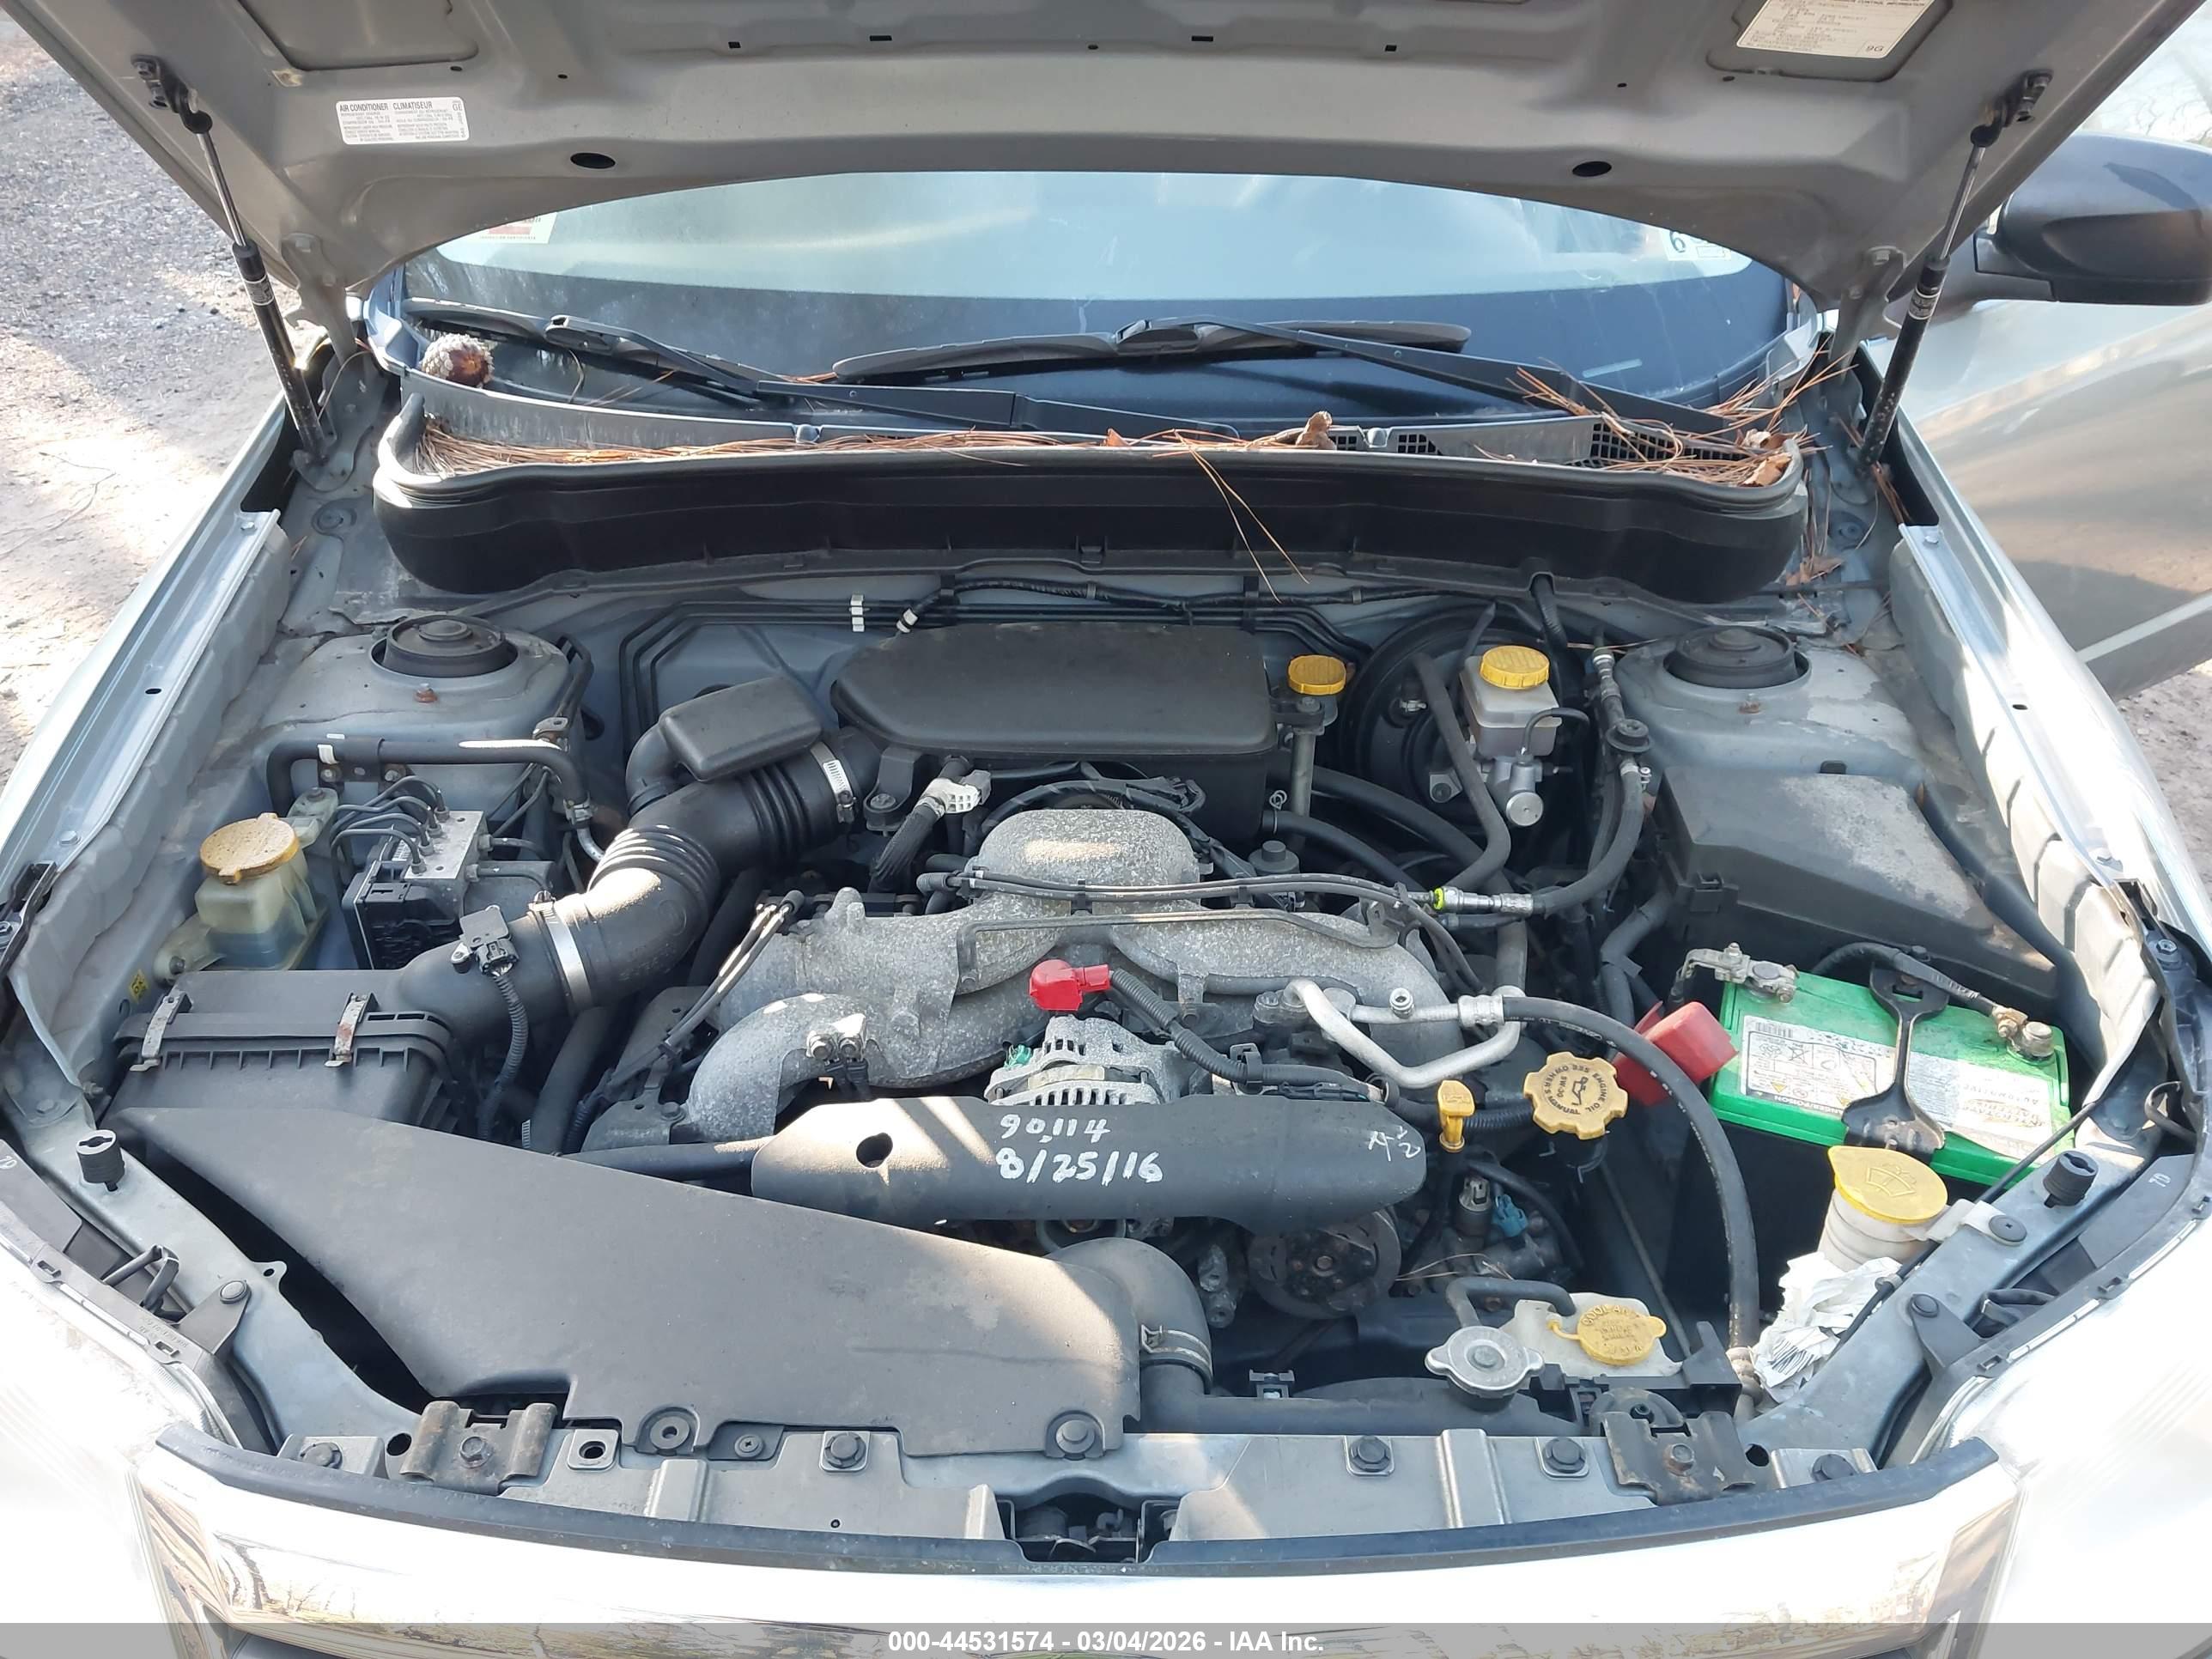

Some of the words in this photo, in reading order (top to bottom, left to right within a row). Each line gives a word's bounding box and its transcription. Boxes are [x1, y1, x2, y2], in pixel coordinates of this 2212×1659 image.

[339, 102, 349, 112] AIR
[350, 102, 389, 112] CONDITIONER
[392, 100, 433, 111] CLIMATISEUR
[1591, 1072, 1608, 1103] ENGINE
[1547, 1095, 1581, 1115] MANUAL
[1584, 1102, 1601, 1113] OIL
[1774, 1095, 1844, 1115] ANGER/POISON
[994, 1147, 1164, 1186] 8/25/16
